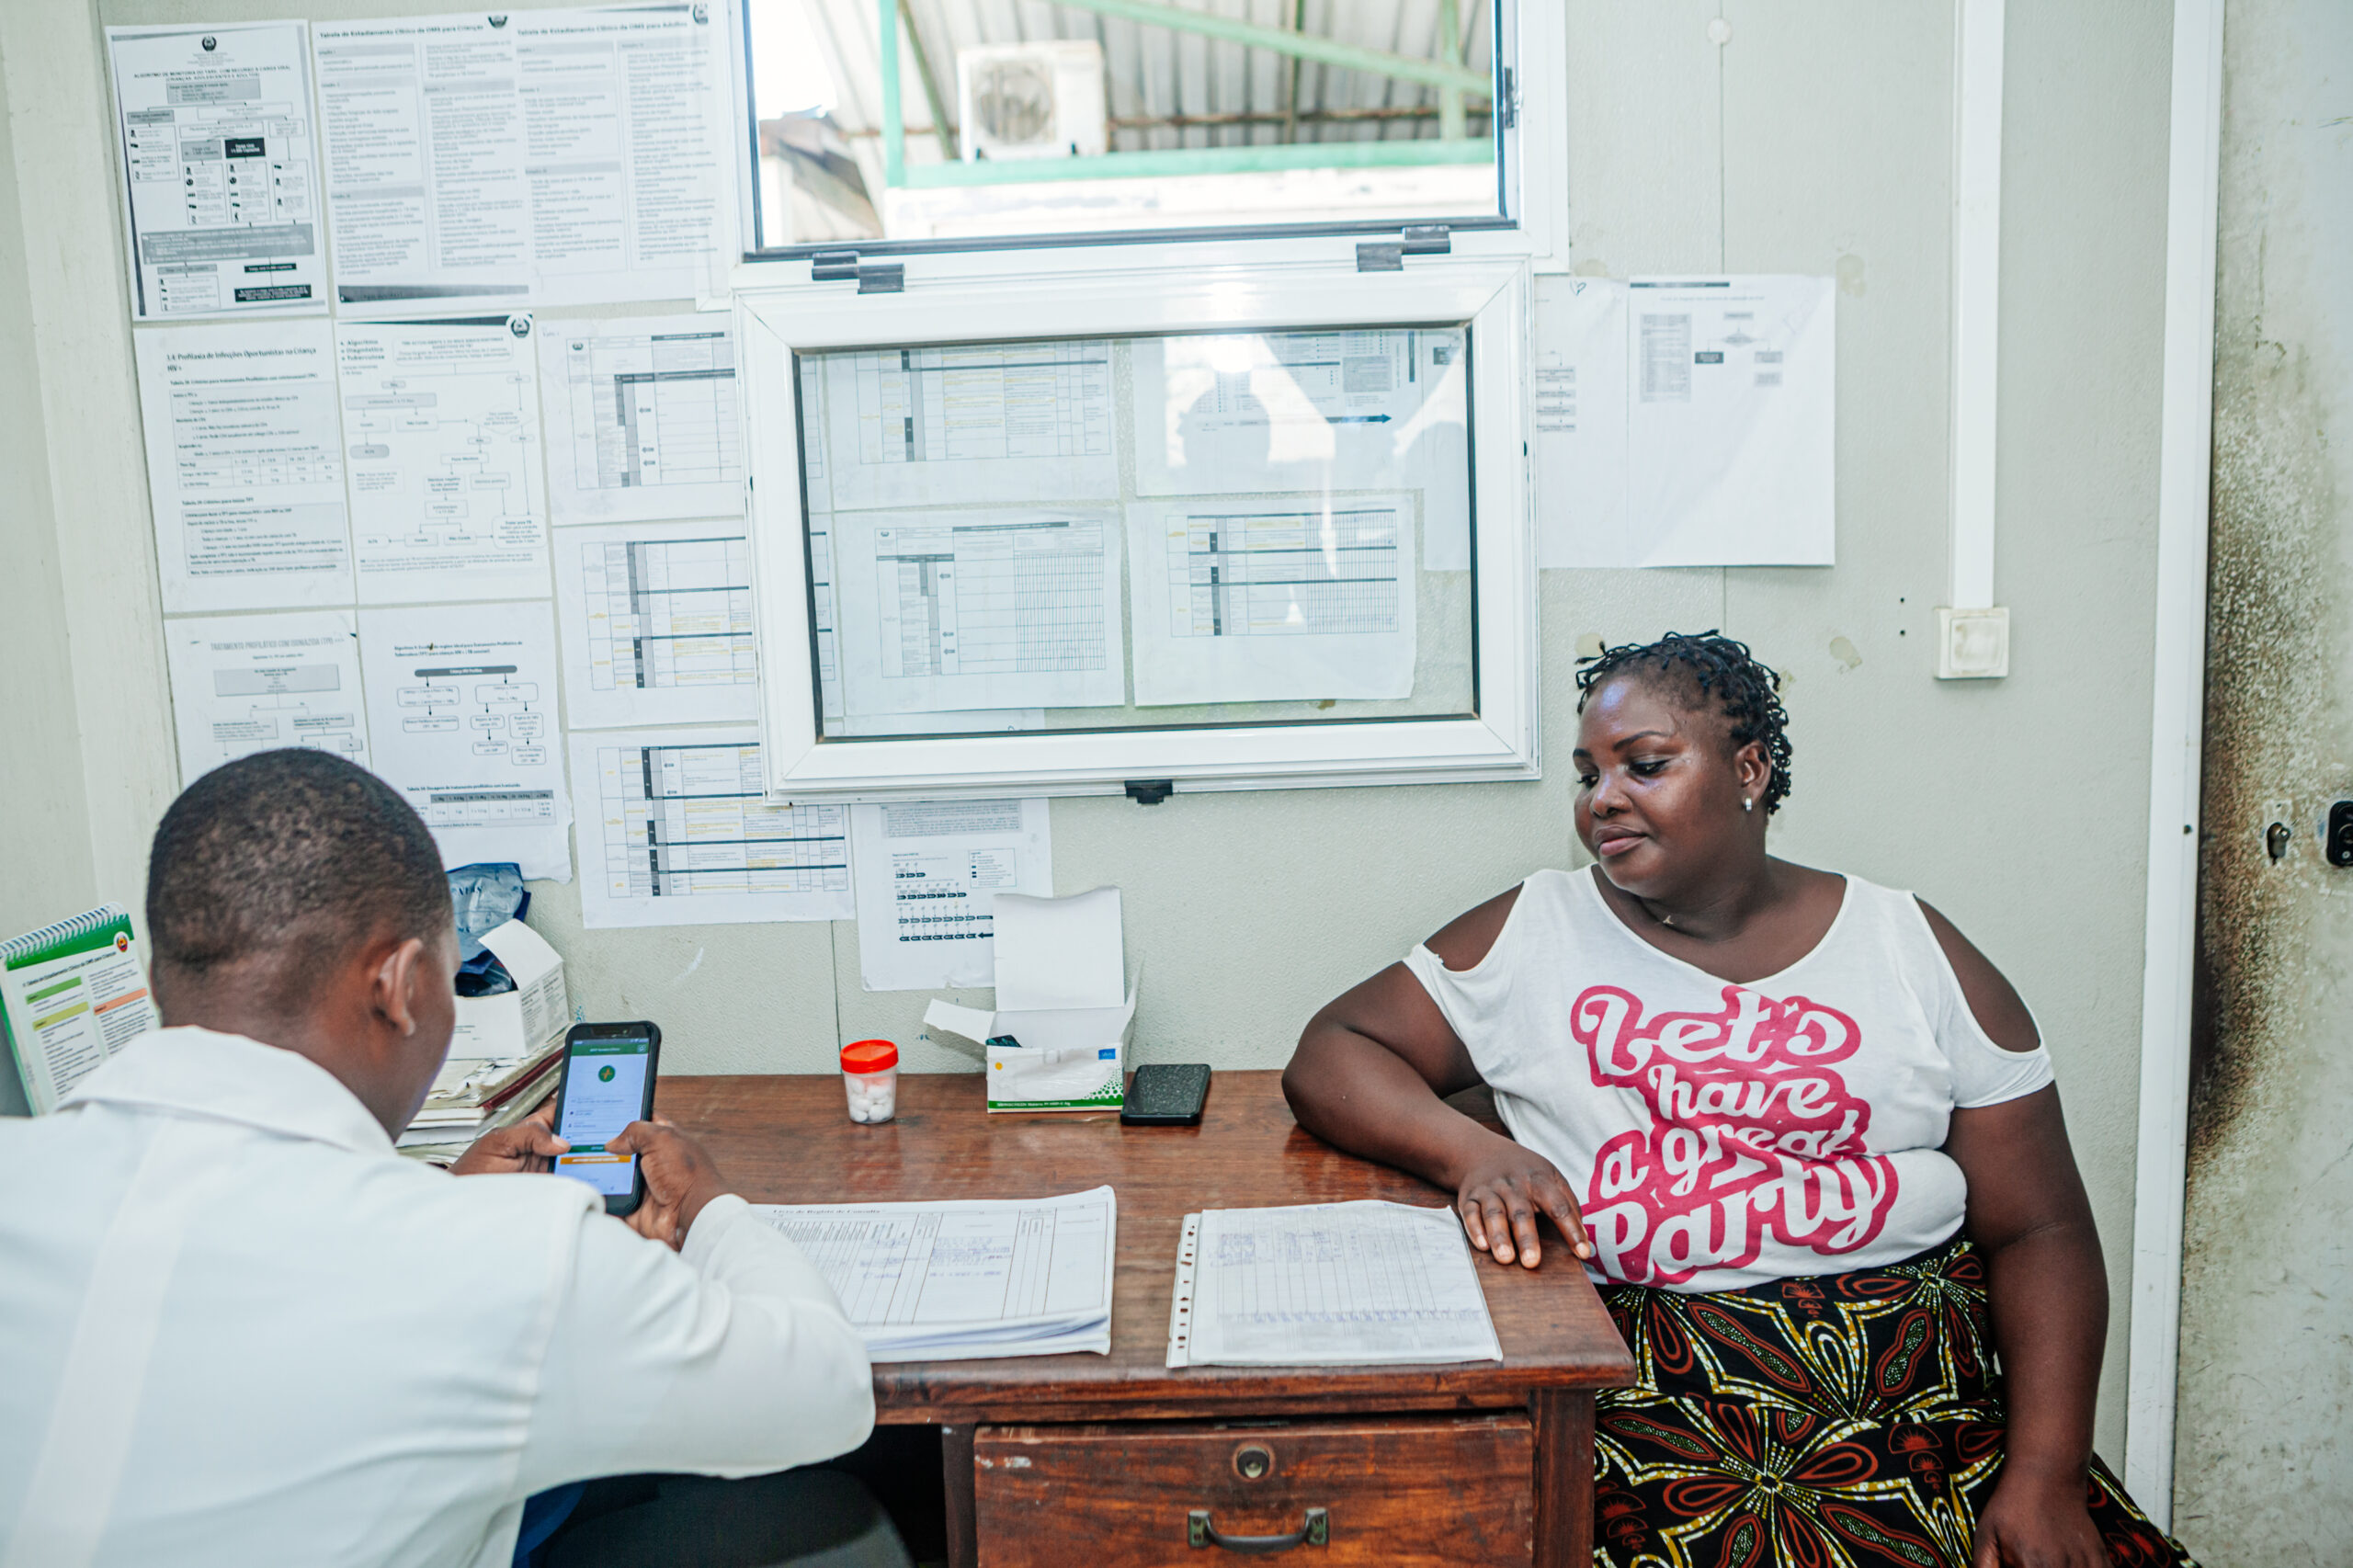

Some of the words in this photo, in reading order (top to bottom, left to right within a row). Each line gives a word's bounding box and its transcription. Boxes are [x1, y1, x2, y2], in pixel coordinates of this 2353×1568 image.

[1576, 988, 1849, 1076] Let's
[1647, 1062, 1838, 1120] have
[1599, 1142, 1650, 1200] a
[1660, 1108, 1860, 1197] great
[1582, 1151, 1886, 1285] Party
